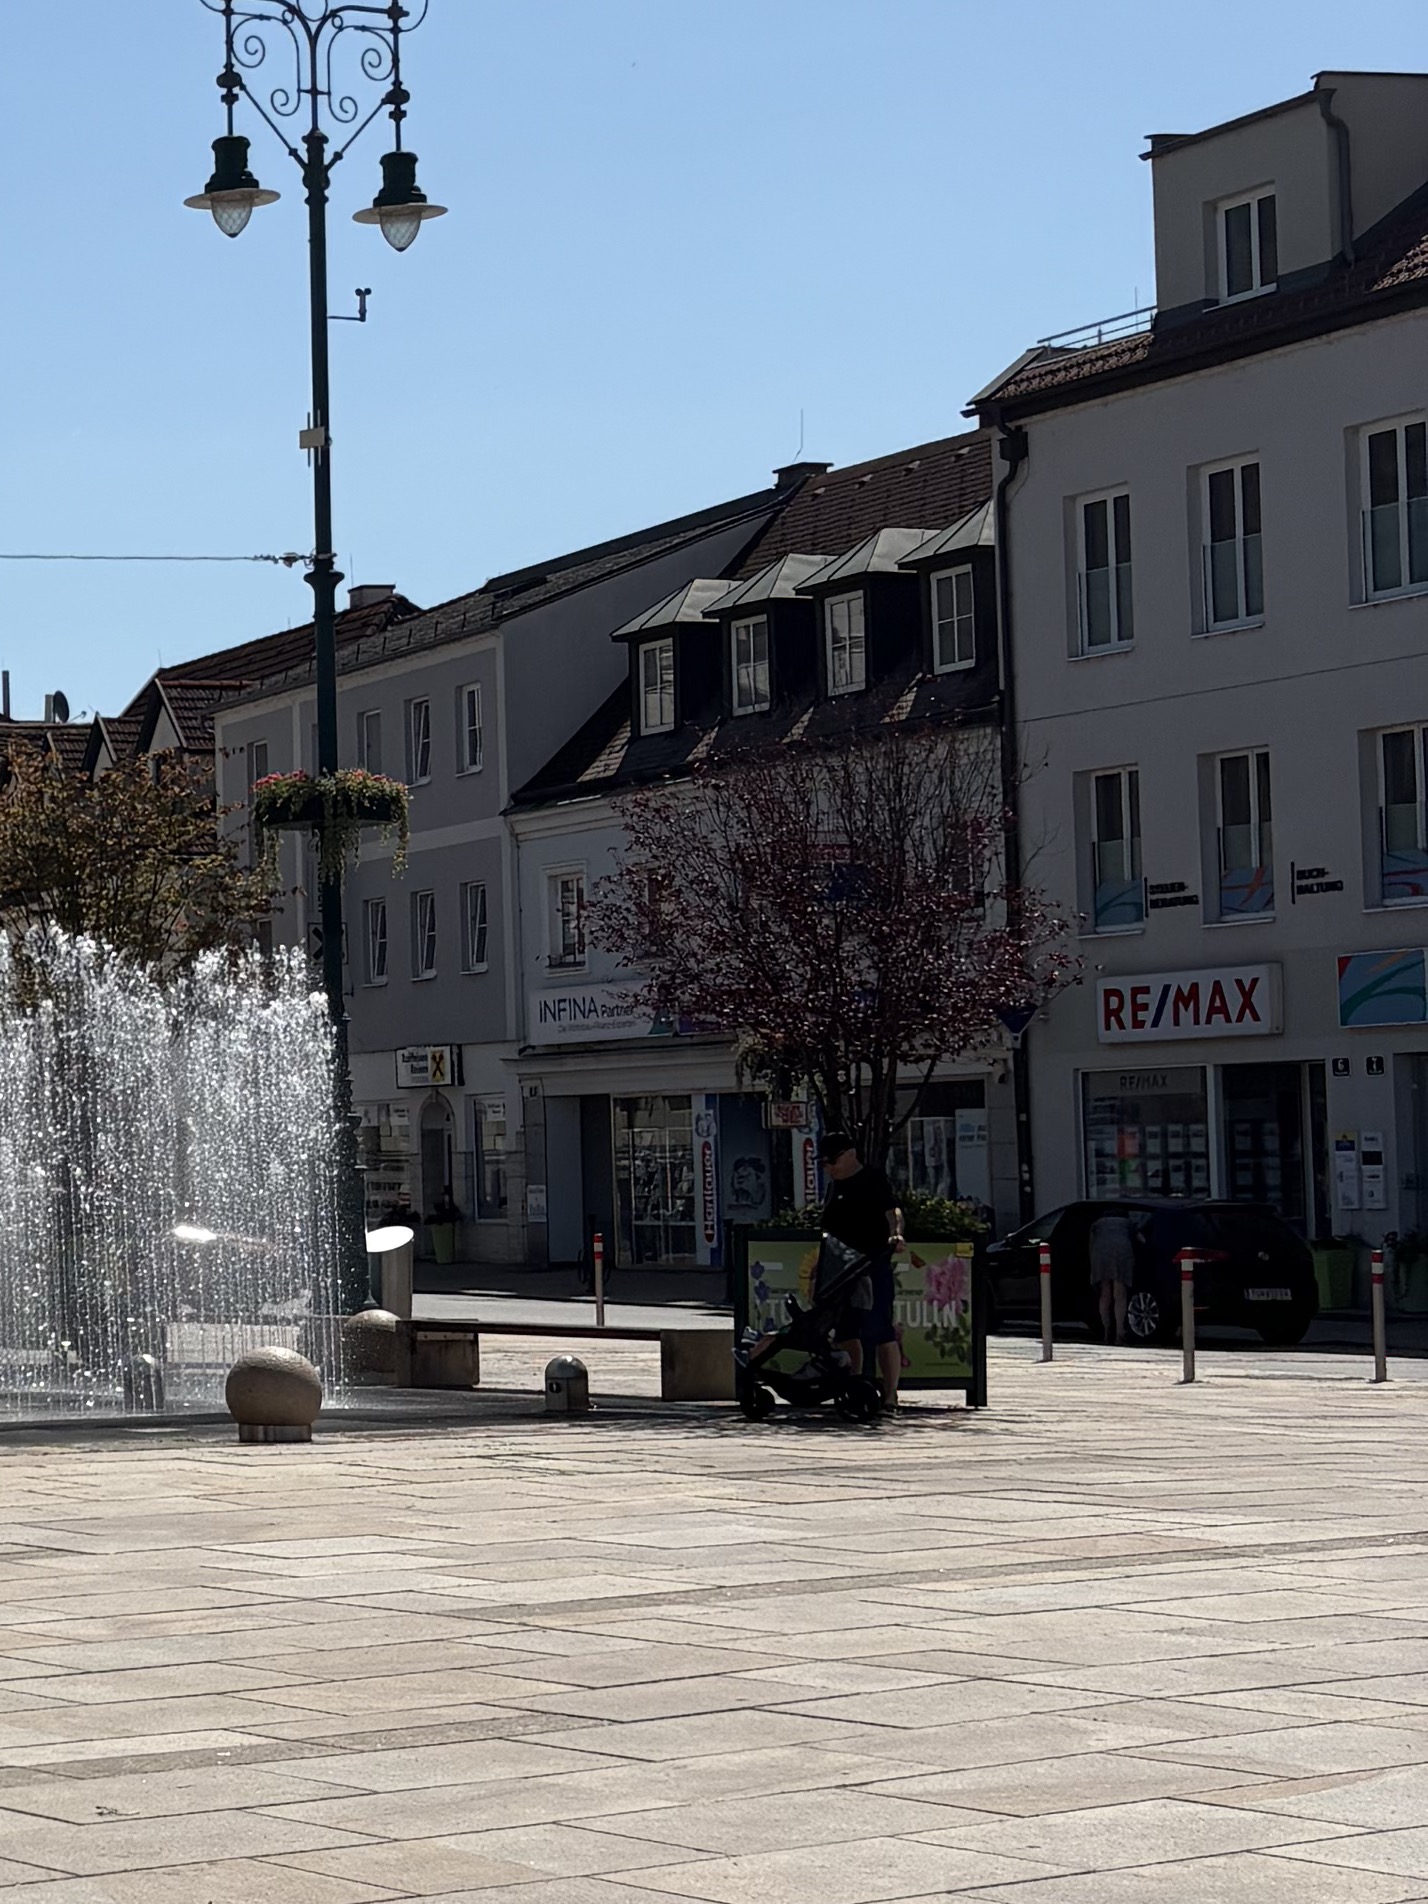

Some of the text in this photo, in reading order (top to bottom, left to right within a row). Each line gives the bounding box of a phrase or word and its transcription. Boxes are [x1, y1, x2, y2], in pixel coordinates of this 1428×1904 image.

[539, 996, 599, 1023] INFINA
[1103, 977, 1262, 1031] RE/MAX
[1119, 1074, 1168, 1089] RE/MAX
[703, 1147, 714, 1234] Hartlauer
[893, 1300, 958, 1328] TULLN
